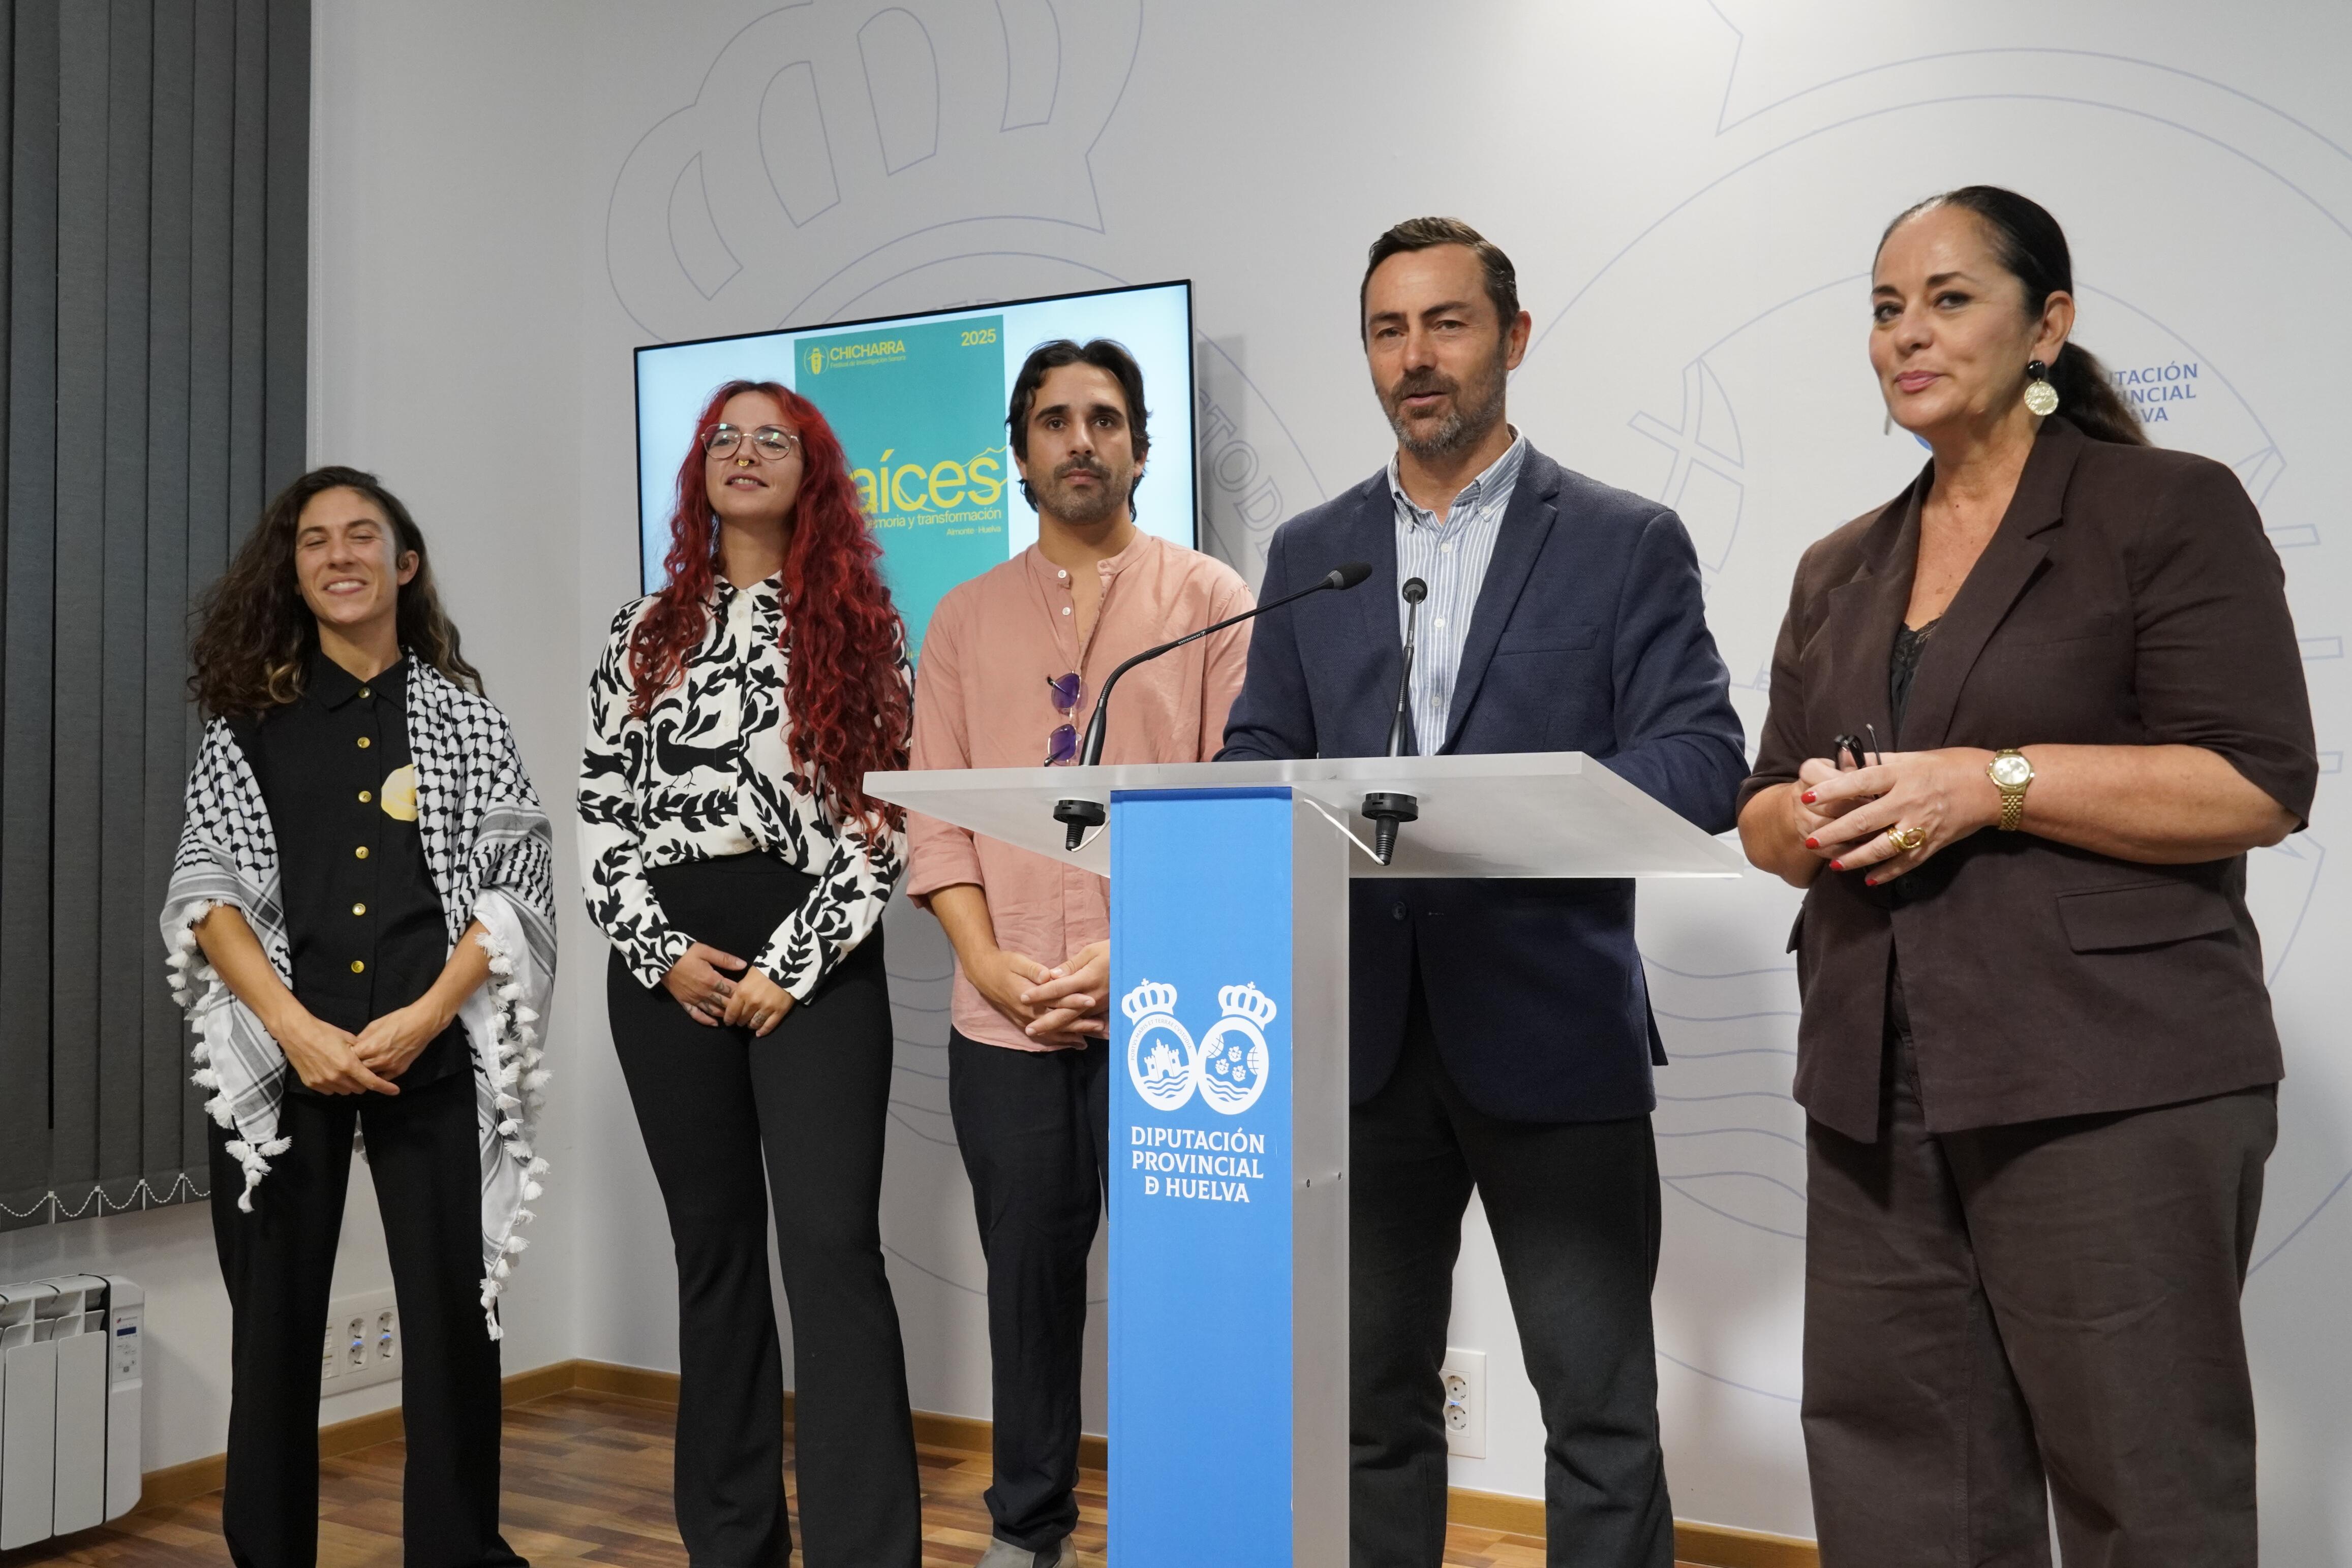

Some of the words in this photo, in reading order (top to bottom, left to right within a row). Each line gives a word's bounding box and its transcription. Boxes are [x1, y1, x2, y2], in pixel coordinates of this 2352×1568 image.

[961, 328, 997, 346] 2025
[830, 340, 905, 361] CHICHARRA
[848, 449, 1001, 514] aíces
[908, 516, 915, 529] y
[917, 507, 1001, 526] transformación
[946, 528, 974, 536] Almonte
[978, 525, 1001, 534] Huelva
[1136, 1024, 1148, 1039] MARIS
[1155, 1018, 1174, 1027] TERRAE
[1174, 1025, 1192, 1050] CVSTODIA
[1131, 1126, 1265, 1154] DIPUTACIÓN
[1132, 1150, 1264, 1179] PROVINCIAL
[1166, 1177, 1250, 1203] HUELVA
